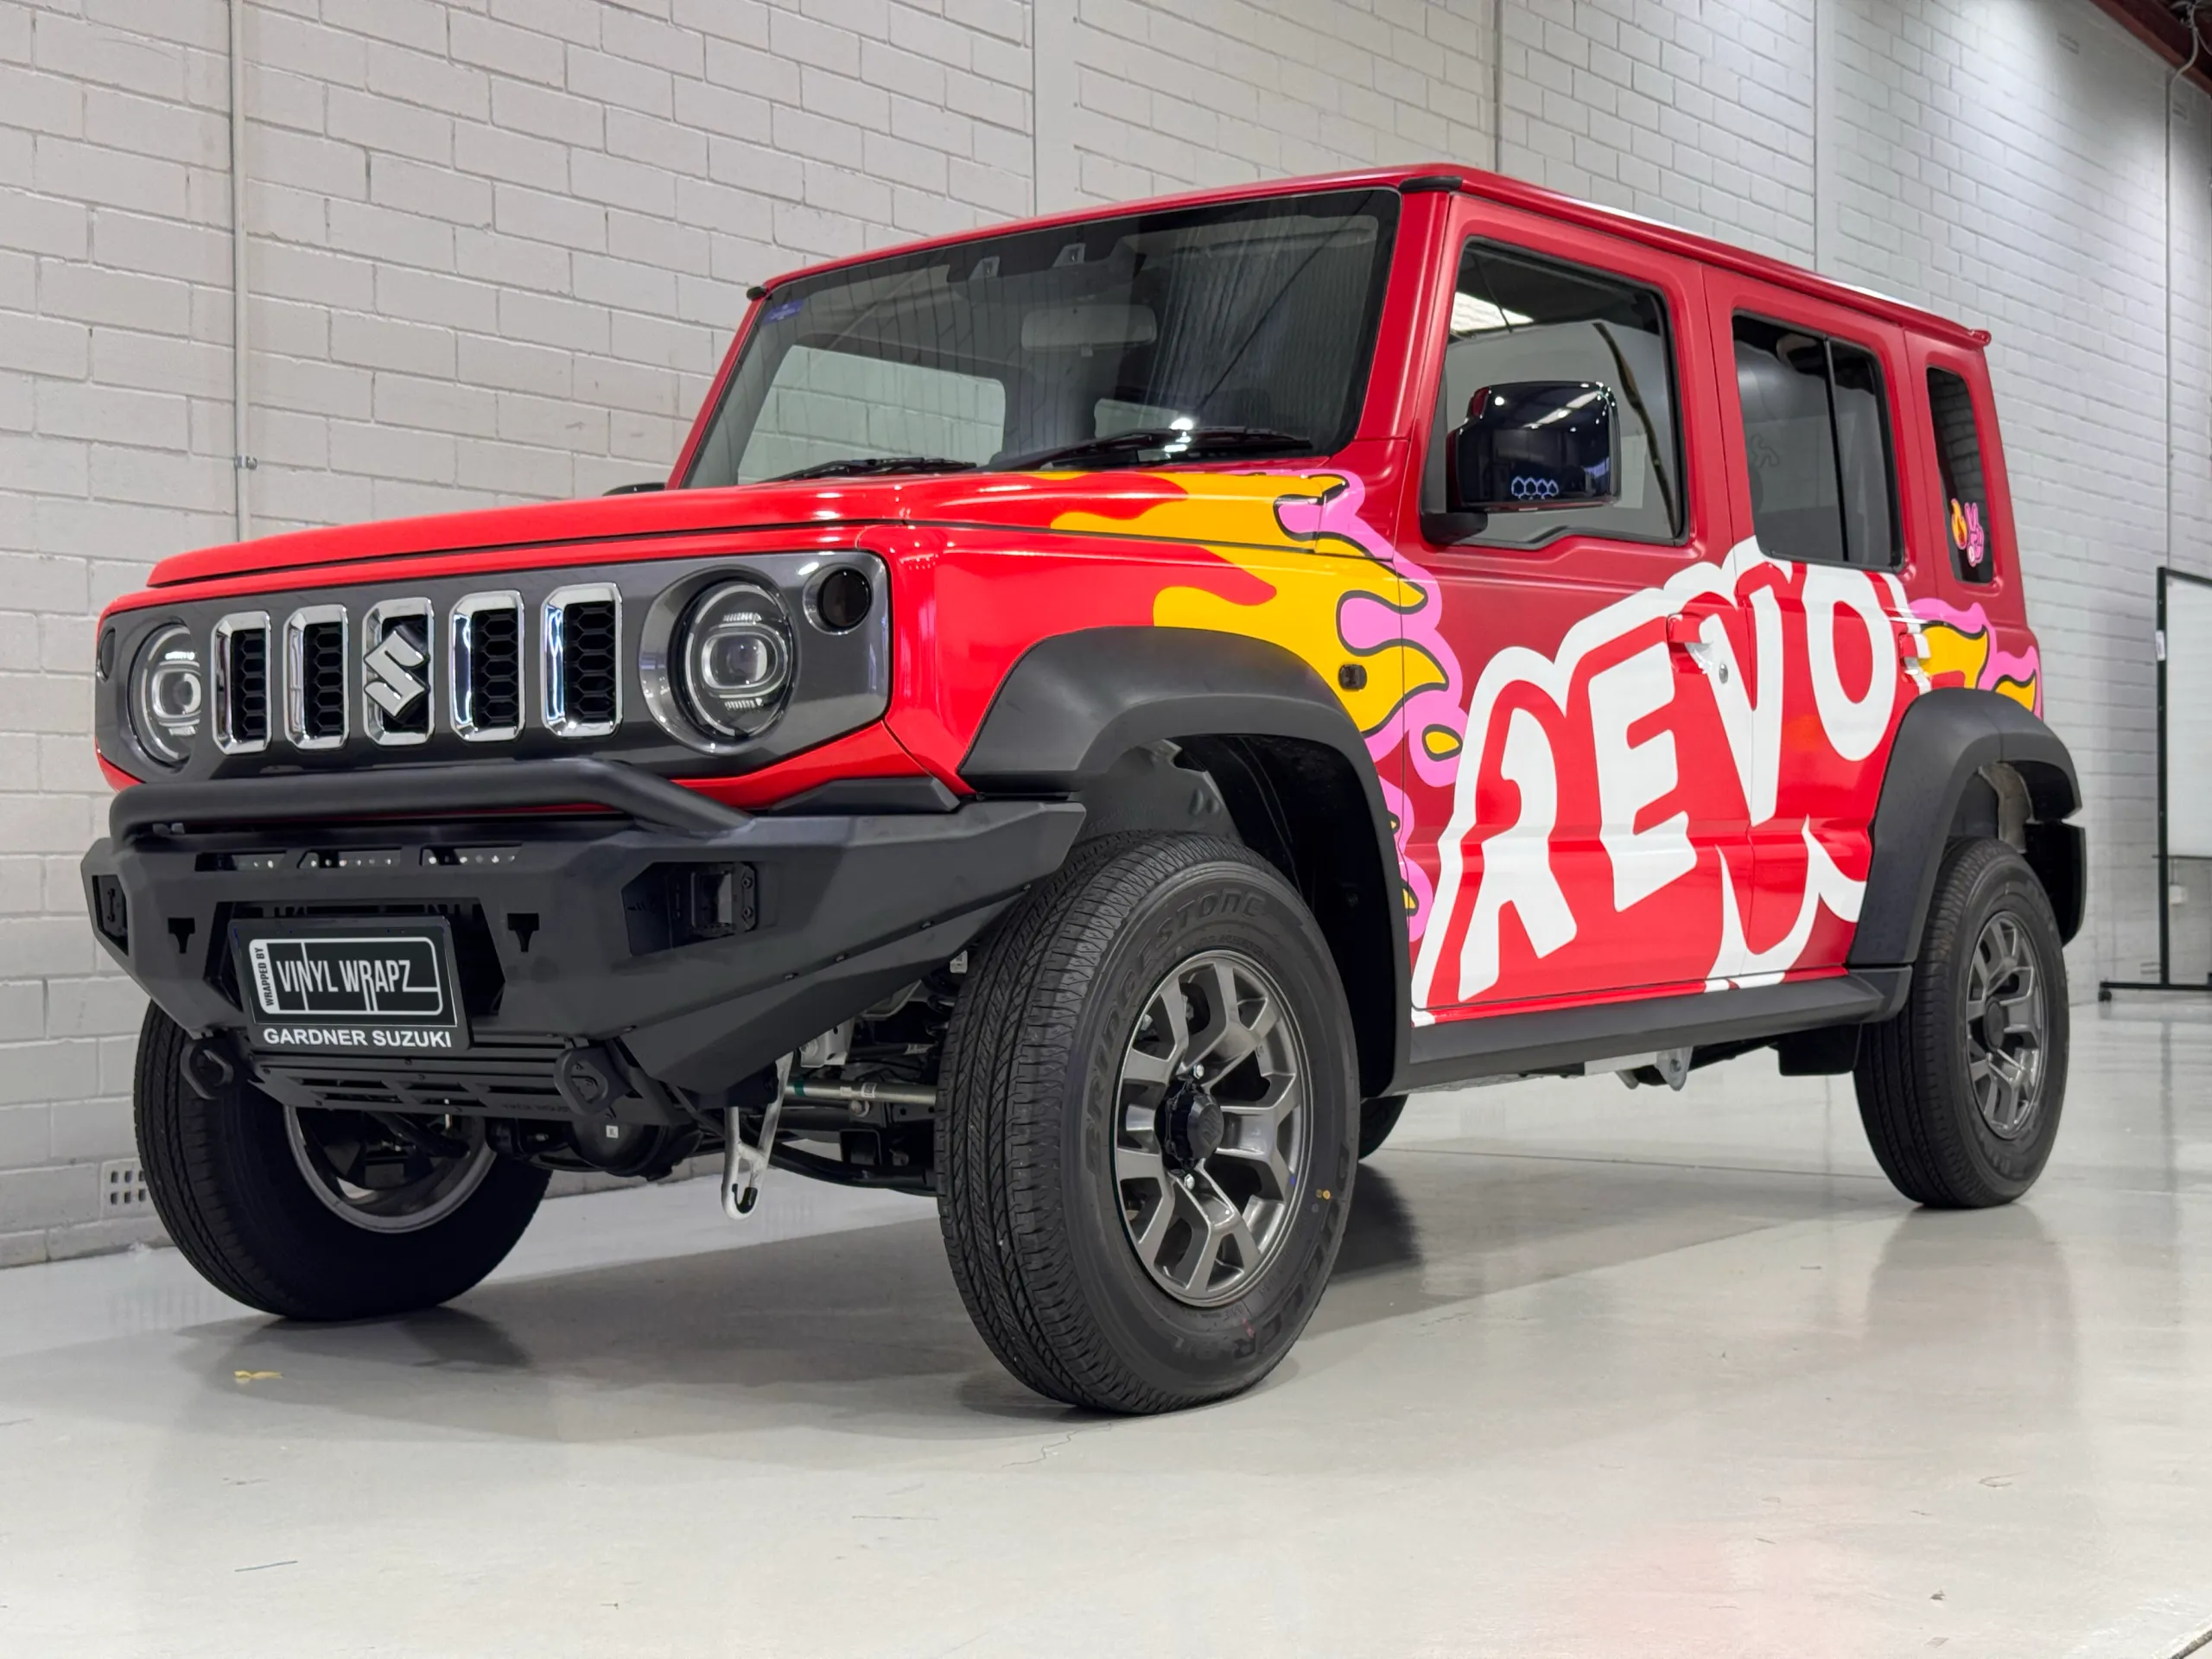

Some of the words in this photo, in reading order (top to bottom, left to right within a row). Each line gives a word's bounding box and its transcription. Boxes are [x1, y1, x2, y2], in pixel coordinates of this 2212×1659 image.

[254, 947, 265, 959] BY
[257, 962, 275, 1007] WRAPPED
[276, 957, 338, 995] VINYL
[339, 959, 416, 998] WRAPZ
[263, 1027, 366, 1046] GARDNER
[372, 1030, 453, 1048] SUZUKI
